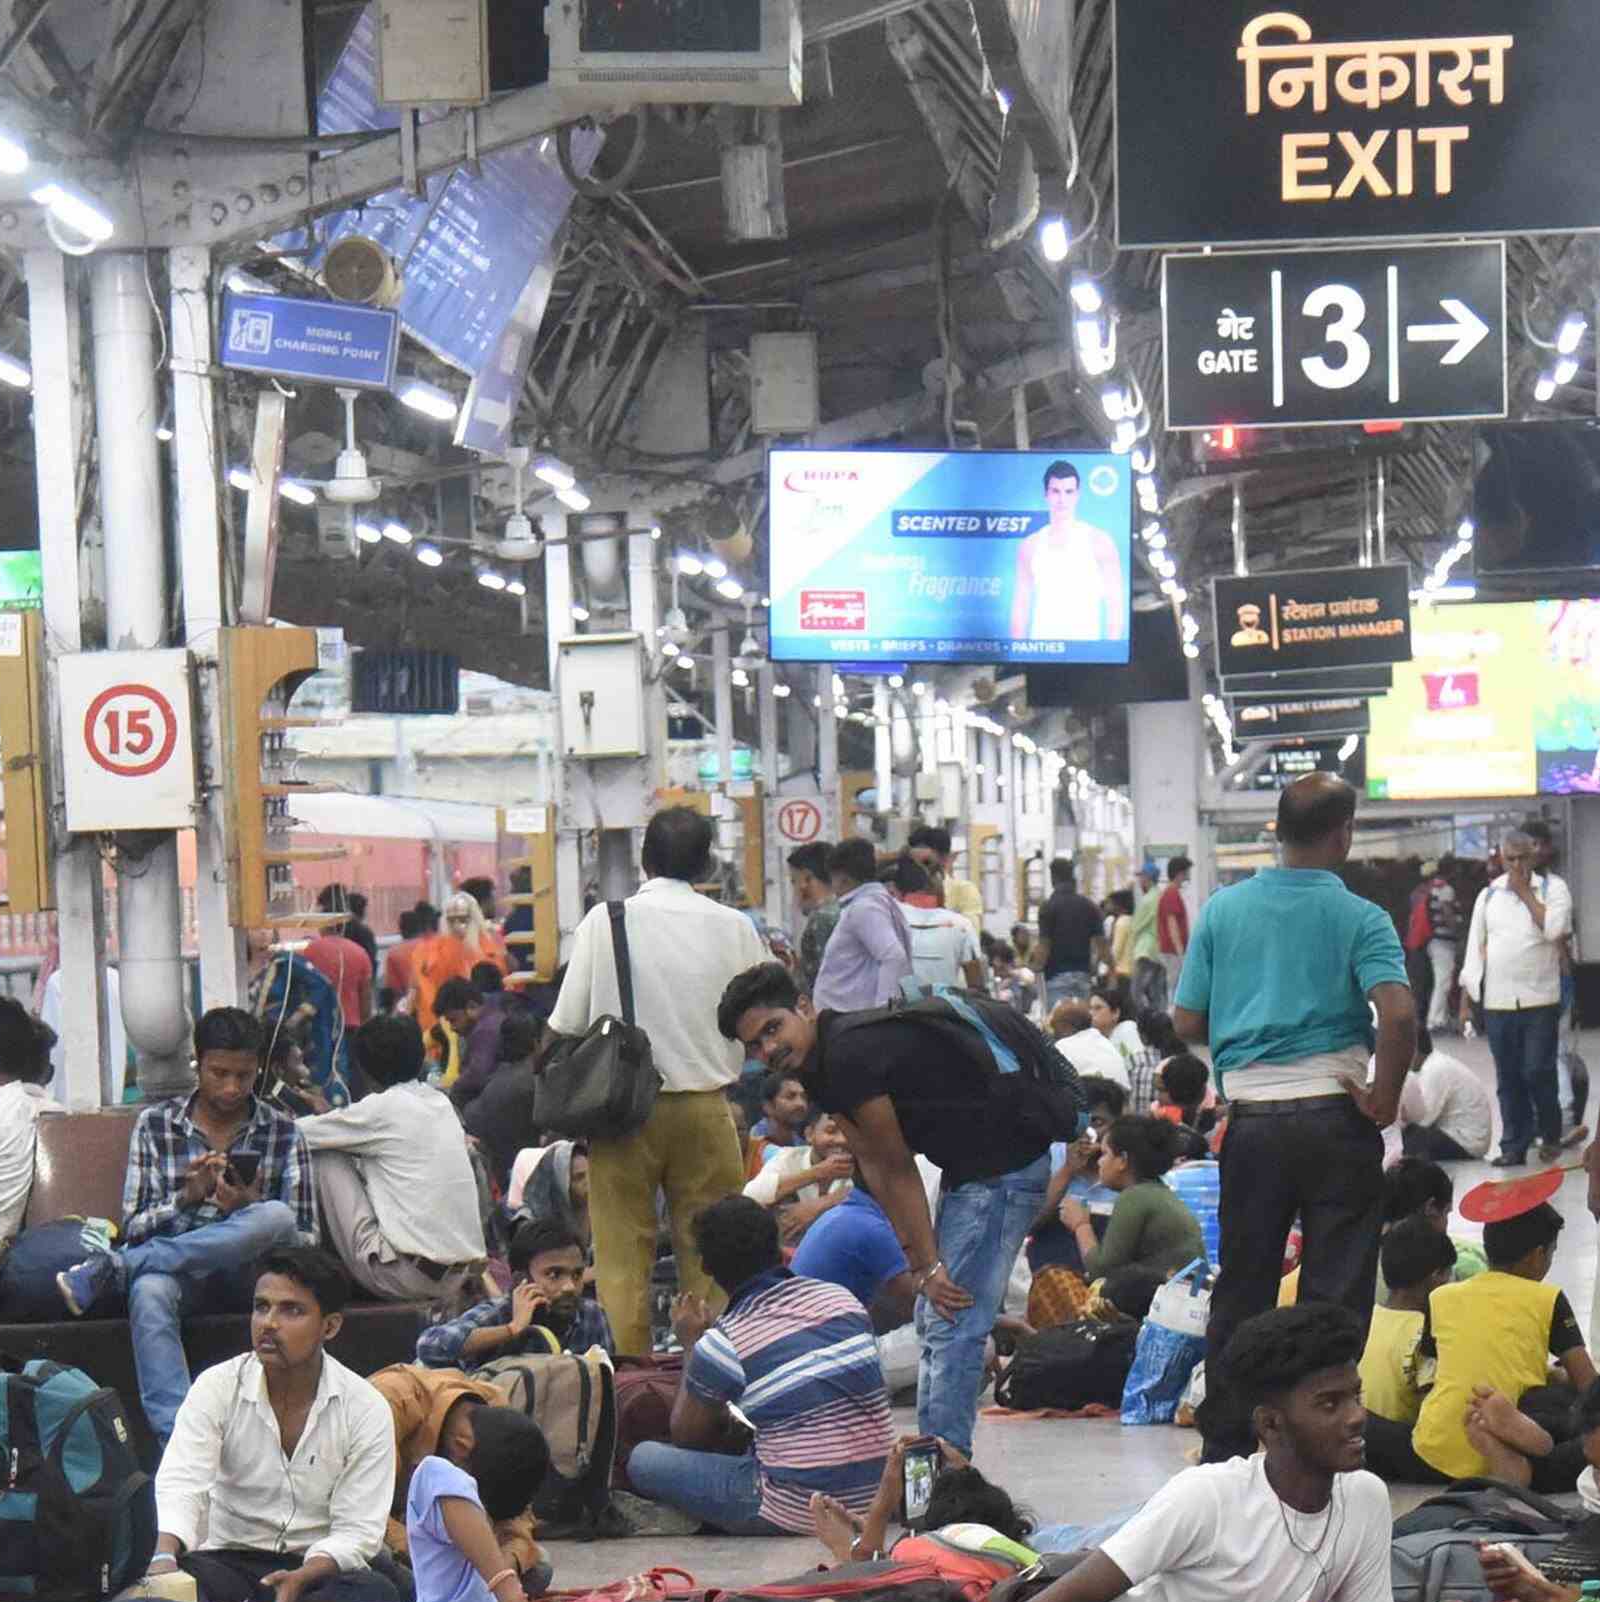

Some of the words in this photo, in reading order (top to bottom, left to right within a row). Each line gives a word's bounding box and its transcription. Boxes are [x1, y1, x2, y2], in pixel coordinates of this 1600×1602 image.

[1237, 12, 1513, 114] निकास
[1282, 126, 1469, 201] EXIT
[305, 326, 353, 342] MOBILE
[1217, 308, 1254, 341] गेट
[1301, 284, 1371, 389] 3
[273, 338, 340, 356] CHARGING
[342, 347, 381, 361] POINT
[1197, 349, 1258, 374] GATE
[897, 515, 979, 531] SCENTED
[985, 516, 1032, 532] VEST
[908, 574, 1003, 600] Fragrance
[1281, 625, 1337, 642] STATION
[1338, 619, 1404, 639] MANAGER
[881, 639, 926, 652] BRIEFS
[1012, 641, 1065, 653] PANTIES
[103, 709, 155, 755] 15
[787, 808, 810, 834] 17
